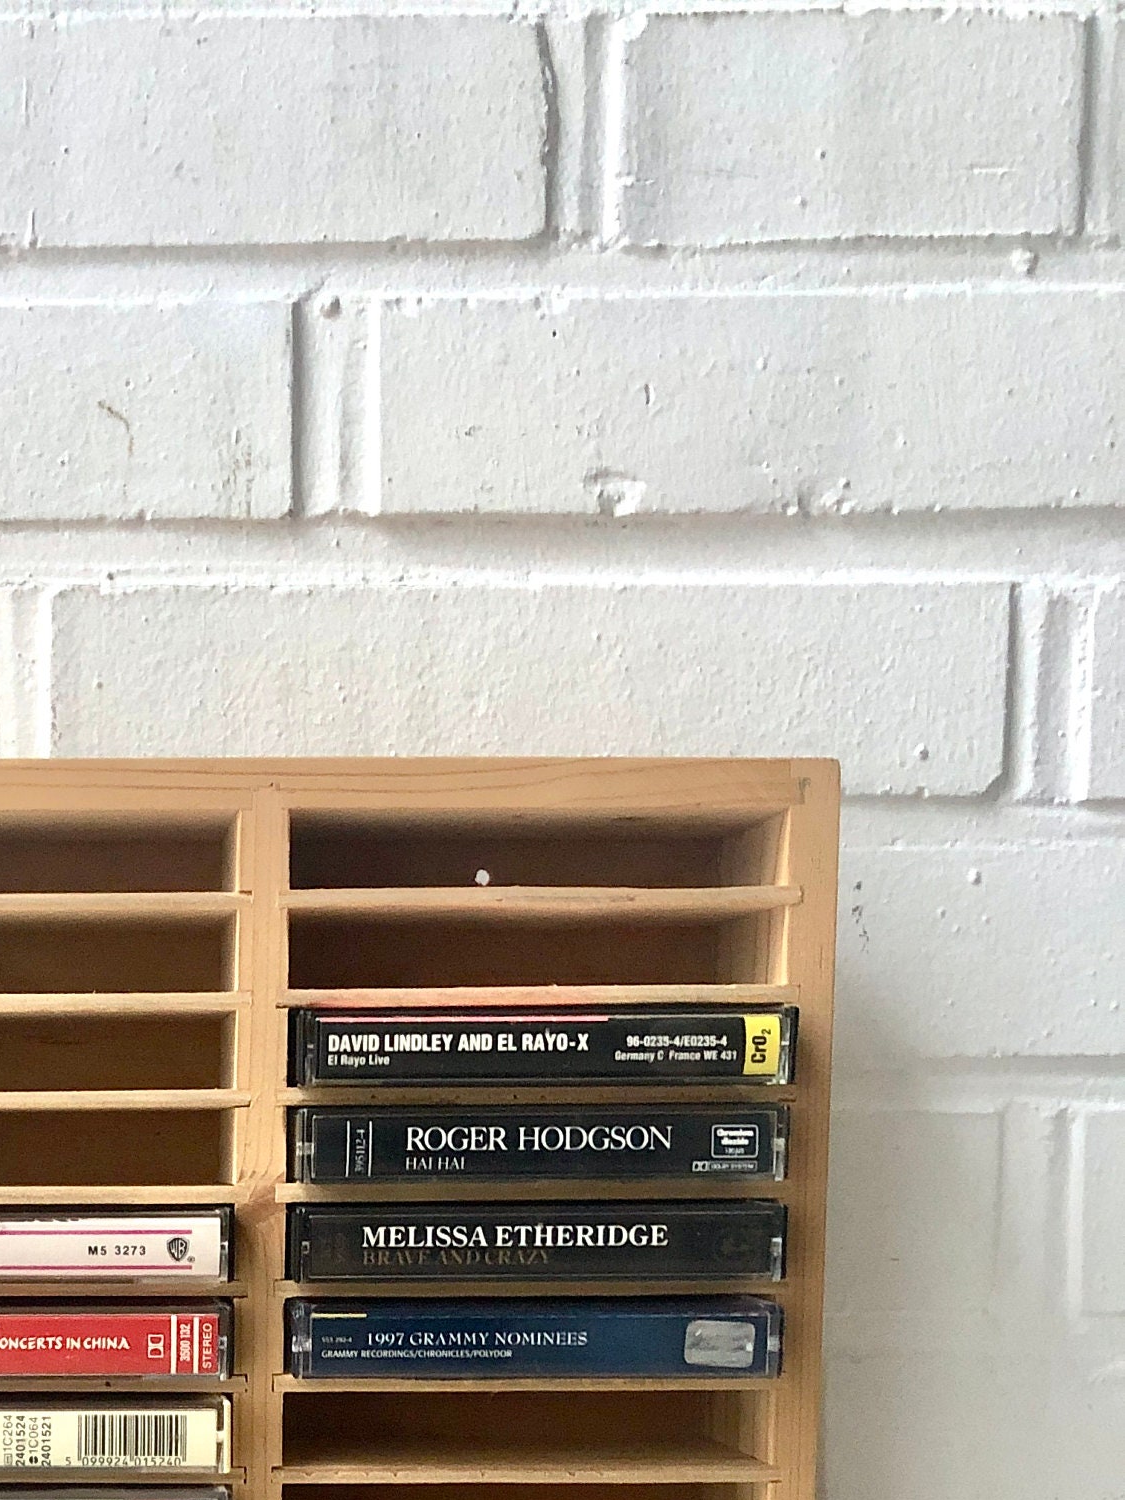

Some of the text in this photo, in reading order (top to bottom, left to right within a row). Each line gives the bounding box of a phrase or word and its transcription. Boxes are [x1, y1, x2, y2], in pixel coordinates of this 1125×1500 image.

[328, 1034, 588, 1052] DAVID LINDLEY AND EL RAYO-X
[626, 1035, 727, 1047] 96-0235-4/E0235-4
[328, 1055, 390, 1068] El Rayo Live
[615, 1051, 655, 1063] Germany
[669, 1051, 700, 1060] France
[704, 1051, 718, 1060] WE
[720, 1051, 737, 1060] 431
[406, 1127, 673, 1150] ROGER HODGSON
[405, 1157, 465, 1170] HAI HAI
[362, 1226, 487, 1247] MELISSA
[495, 1223, 668, 1246] ETHERIDGE
[88, 1246, 146, 1255] M5 3273
[364, 1249, 430, 1265] BRAVE
[439, 1250, 480, 1265] AND
[180, 1324, 190, 1338] 132
[66, 1337, 81, 1349] IN
[83, 1337, 130, 1350] CHINA
[203, 1323, 212, 1368] STEREO
[367, 1333, 404, 1345] 1997
[410, 1332, 489, 1345] GRAMMY
[495, 1332, 588, 1346] NOMINEES
[321, 1350, 512, 1359] GRAMMY RECORDINGS/CHRONICLES/POLYDOR
[3, 1415, 13, 1451] 1C264
[28, 1417, 38, 1454] 1C064
[15, 1416, 25, 1466] 2401524
[41, 1416, 51, 1466] 2401521
[65, 1457, 71, 1466] 5
